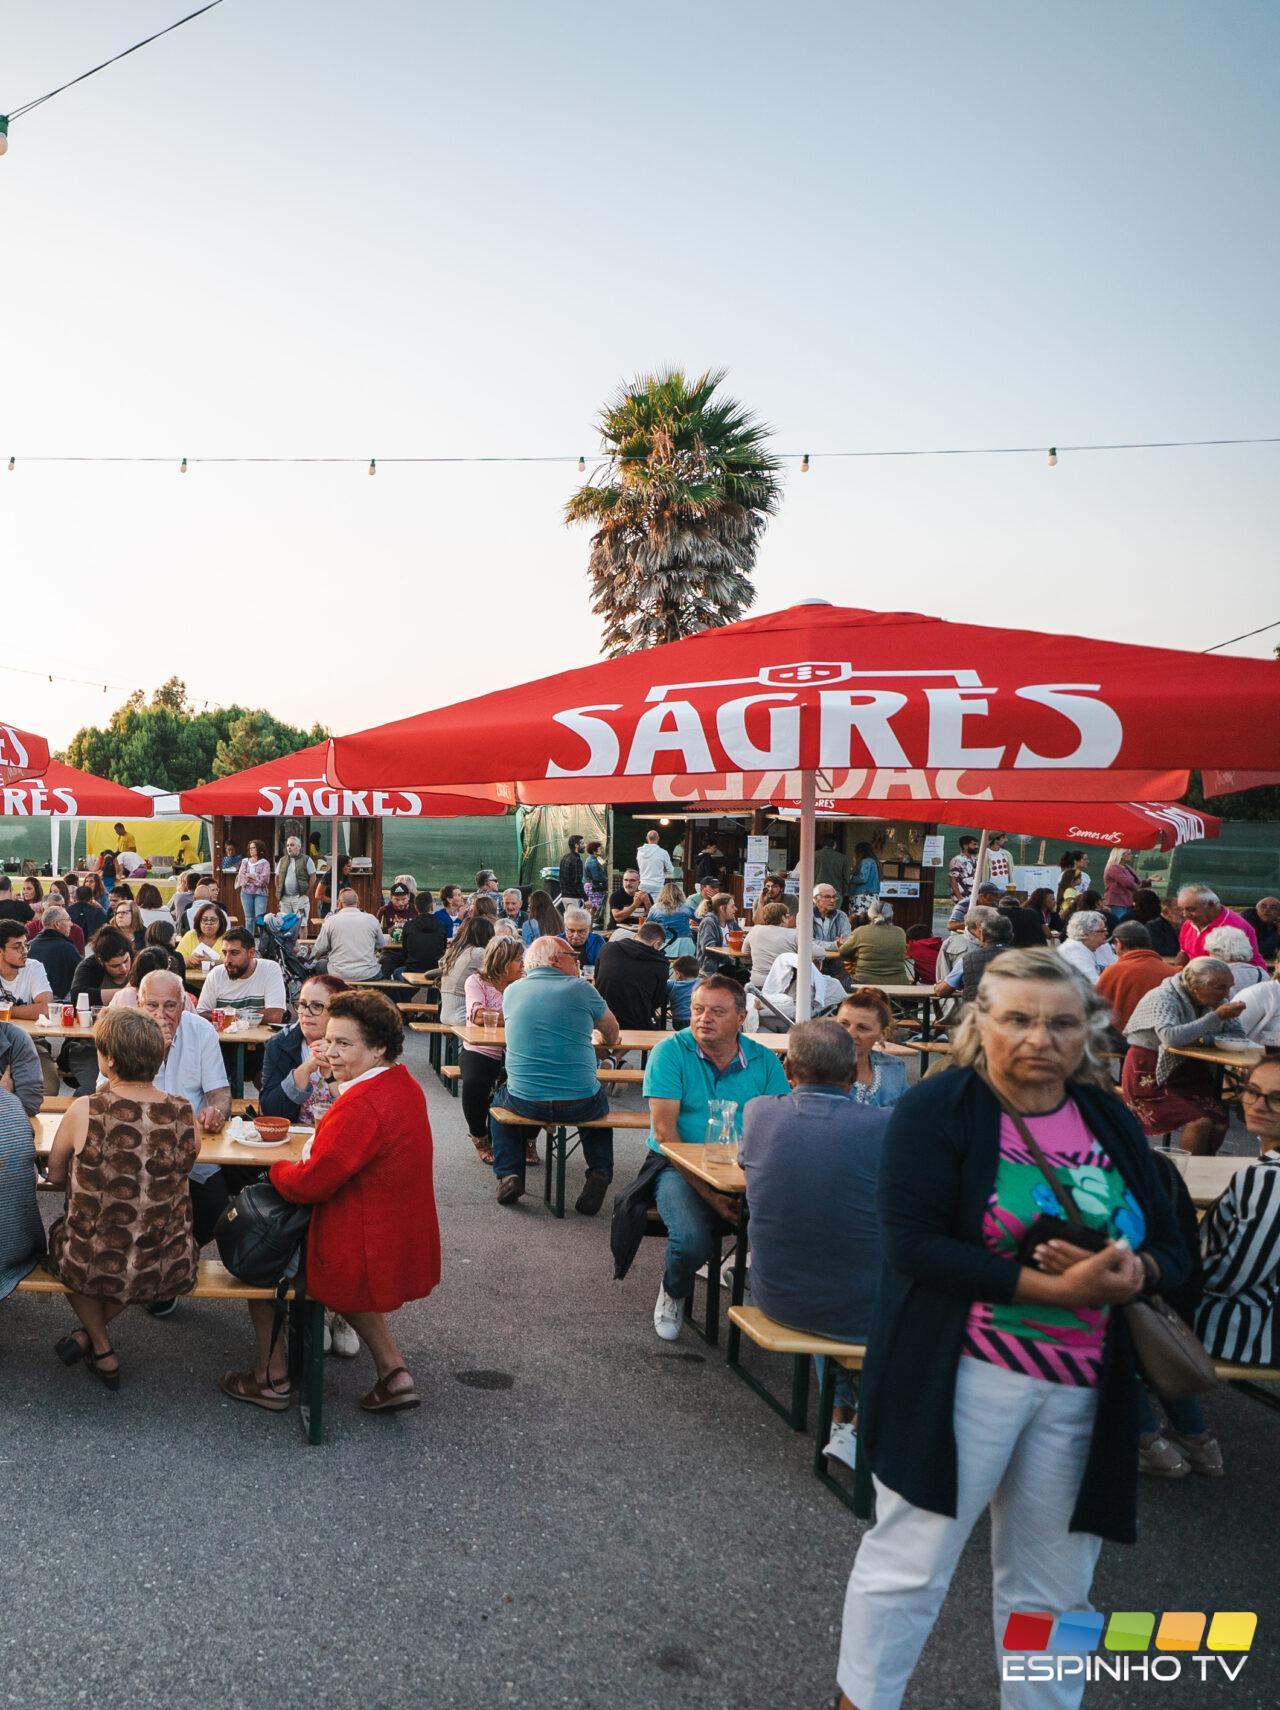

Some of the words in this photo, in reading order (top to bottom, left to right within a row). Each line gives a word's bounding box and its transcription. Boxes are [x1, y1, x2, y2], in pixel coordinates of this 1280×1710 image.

[545, 683, 1123, 778] SAGRES
[257, 786, 422, 816] SAGRES
[1066, 826, 1100, 840] Somos
